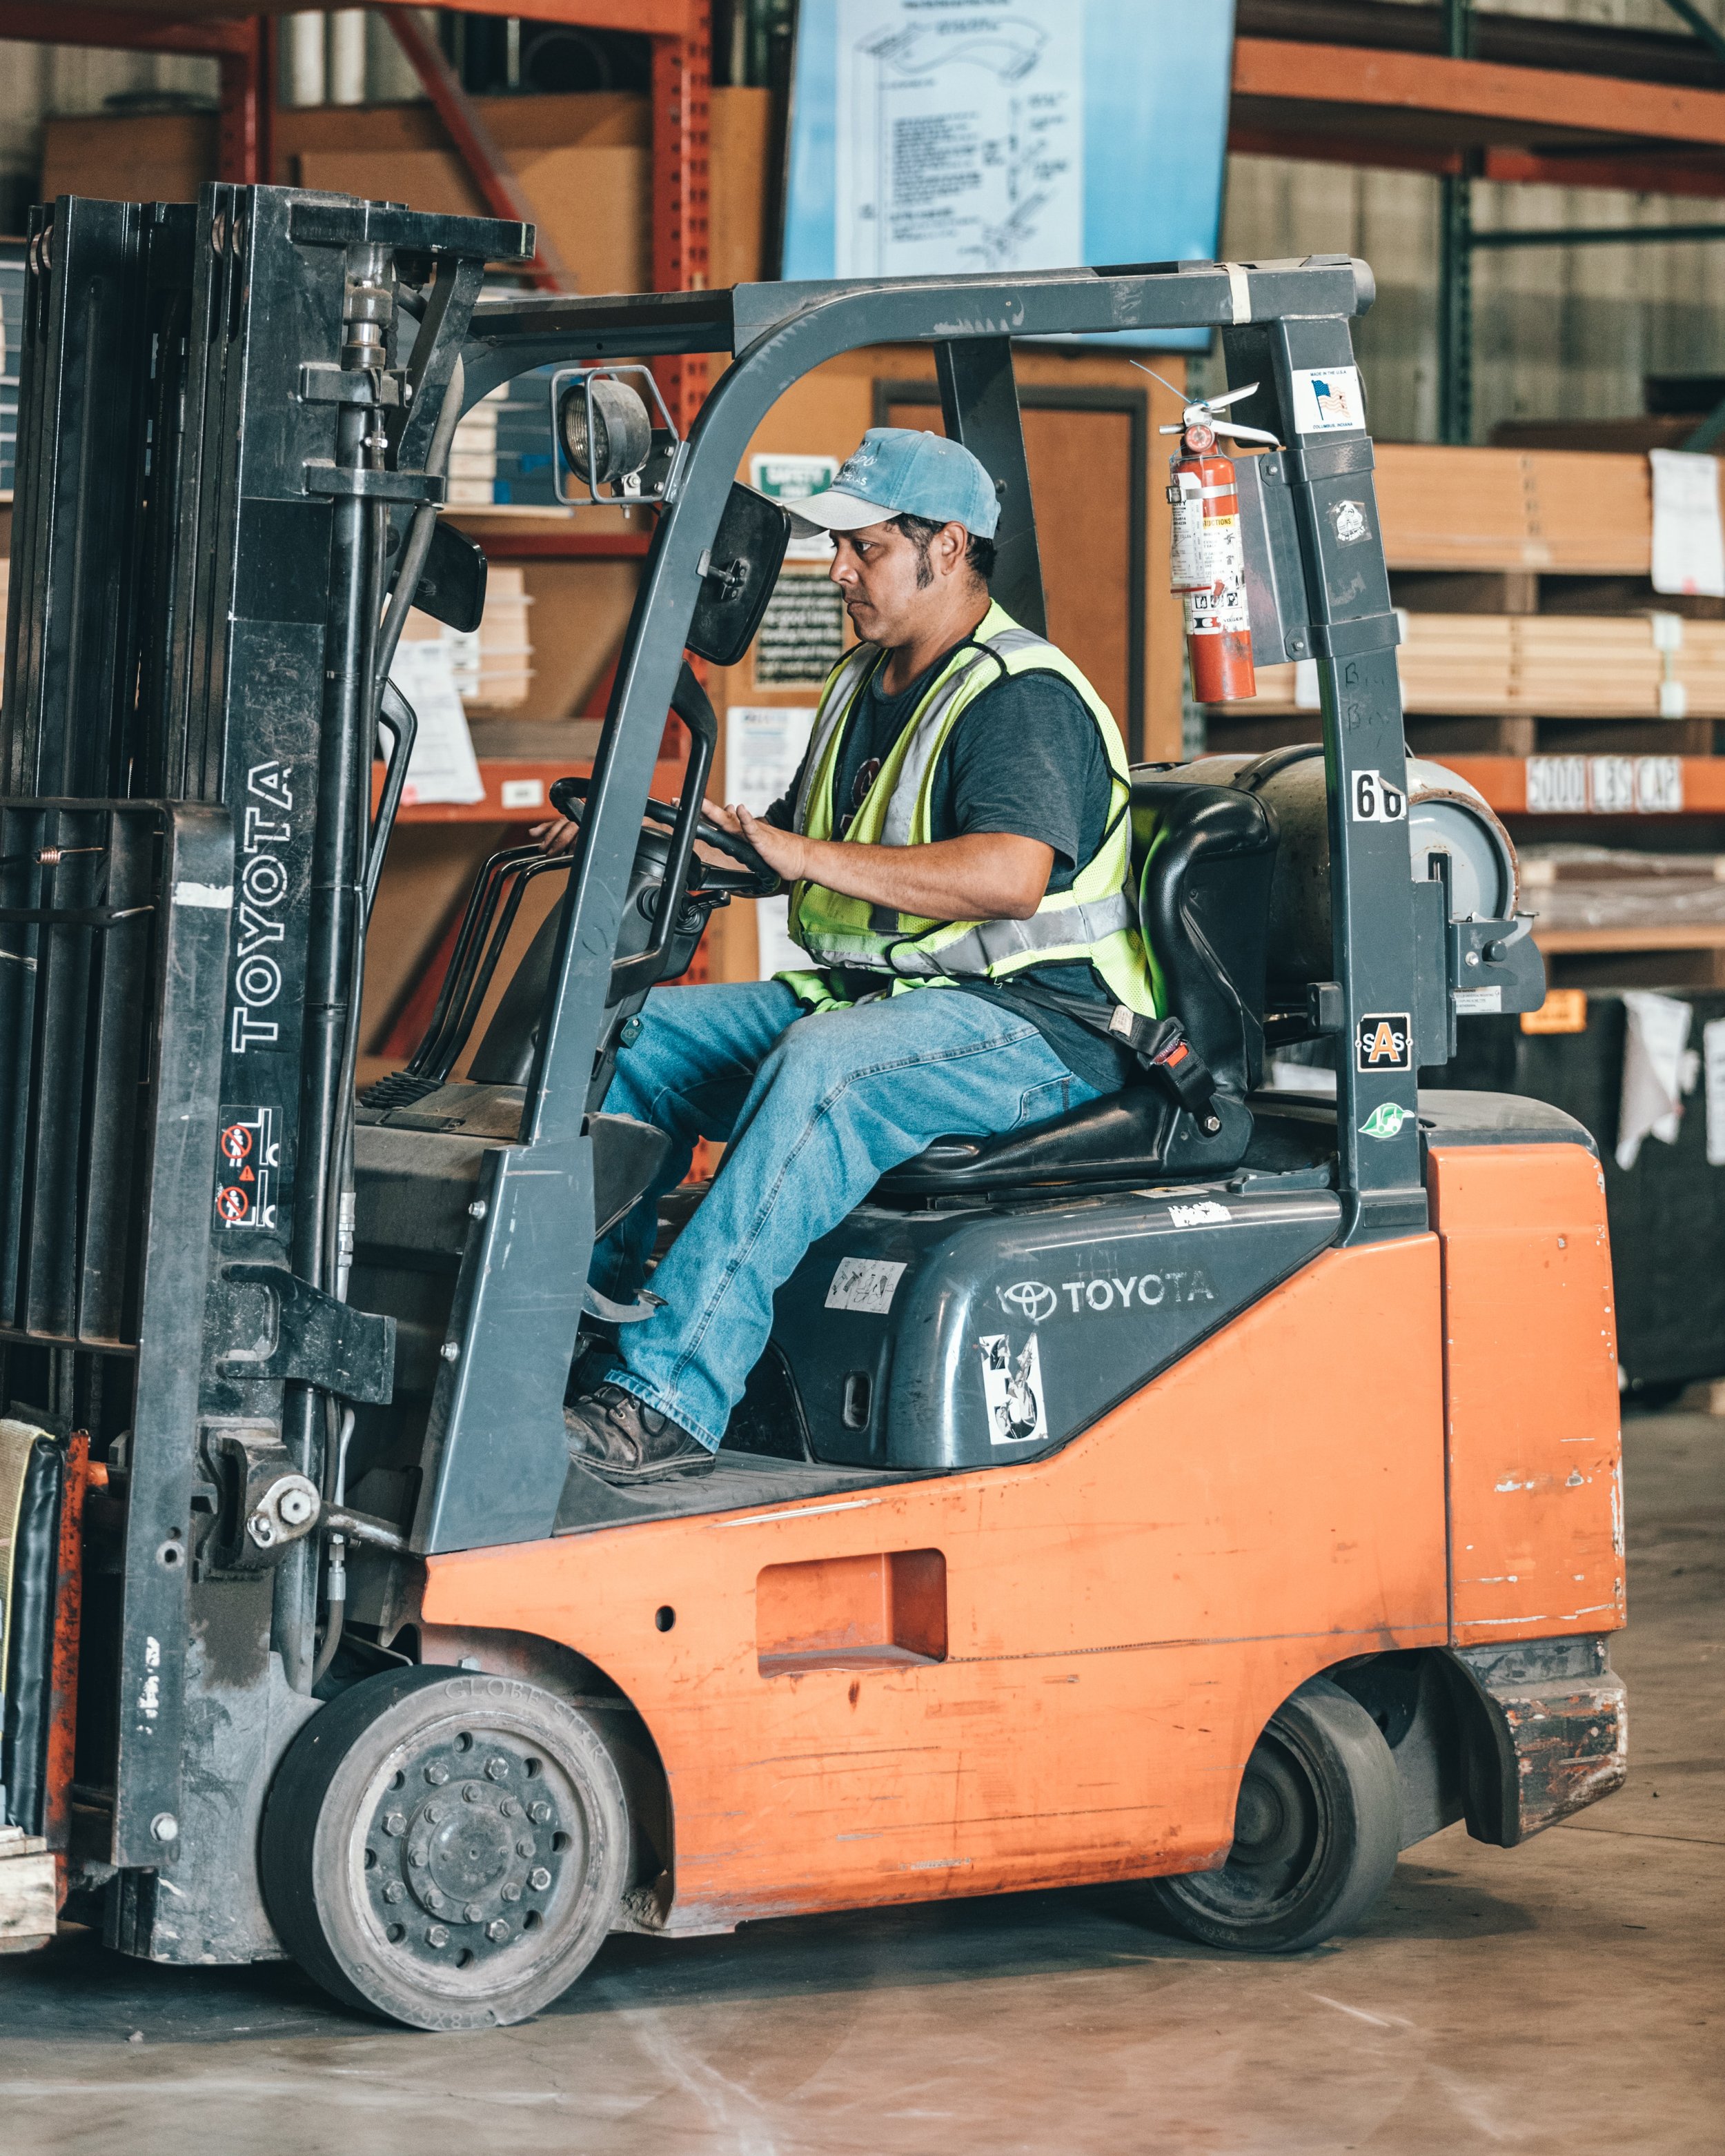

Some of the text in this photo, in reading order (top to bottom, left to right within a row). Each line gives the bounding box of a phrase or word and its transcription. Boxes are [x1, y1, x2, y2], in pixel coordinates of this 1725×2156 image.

[231, 761, 293, 1053] TOYOTA
[1362, 1022, 1405, 1062] SAS
[1062, 1270, 1214, 1312] TOYOTA
[445, 1677, 543, 1708] GLOBE
